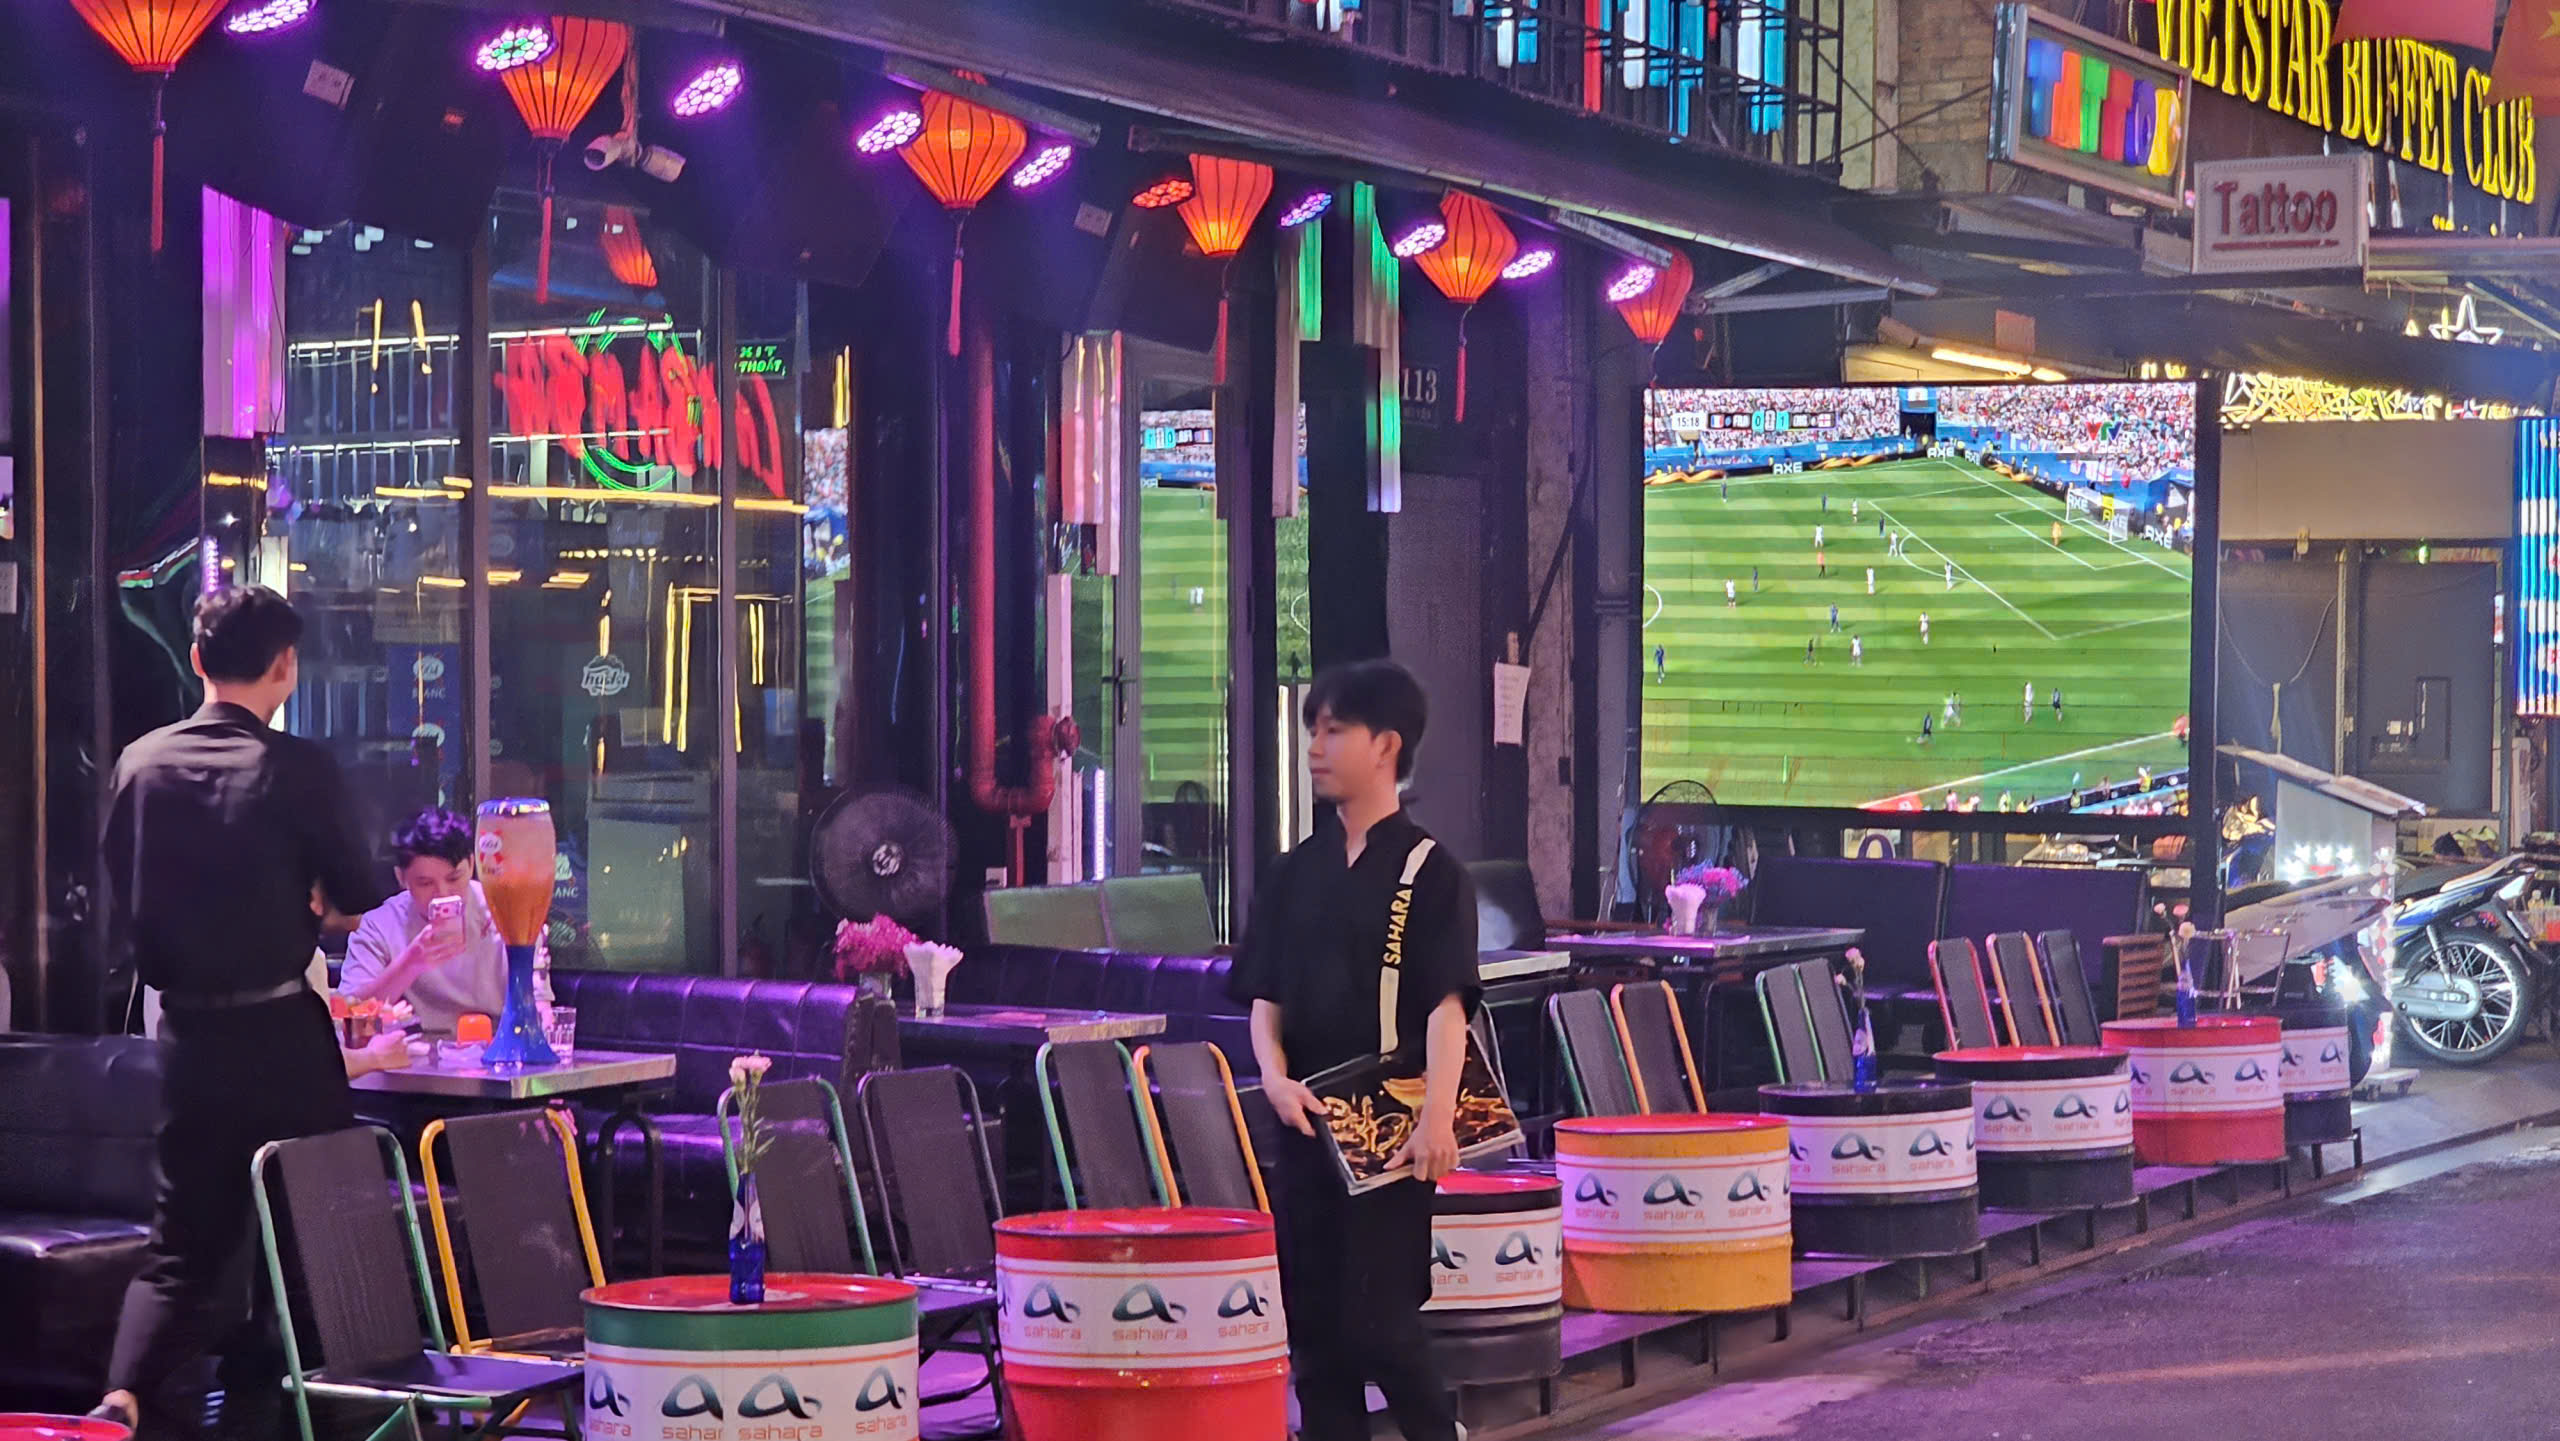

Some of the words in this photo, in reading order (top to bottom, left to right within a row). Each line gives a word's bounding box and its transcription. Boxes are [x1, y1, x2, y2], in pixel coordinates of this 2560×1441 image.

[2340, 36, 2457, 176] BUFFET
[2464, 66, 2537, 205] CLUB
[2213, 181, 2338, 236] Tattoo
[735, 345, 777, 358] XIT
[1402, 367, 1437, 404] 113
[1677, 415, 1700, 428] 15:18
[1754, 415, 1762, 428] 0
[1780, 416, 1785, 428] 1
[1927, 447, 1955, 459] AXE
[1773, 461, 1802, 475] AXE
[2144, 524, 2173, 549] AXE
[411, 687, 446, 699] BANC
[1383, 889, 1413, 965] SAHARA
[1643, 1208, 1705, 1222] sahara
[1112, 1327, 1188, 1343] sahara
[737, 1422, 823, 1441] sahara
[855, 1412, 907, 1435] sahara
